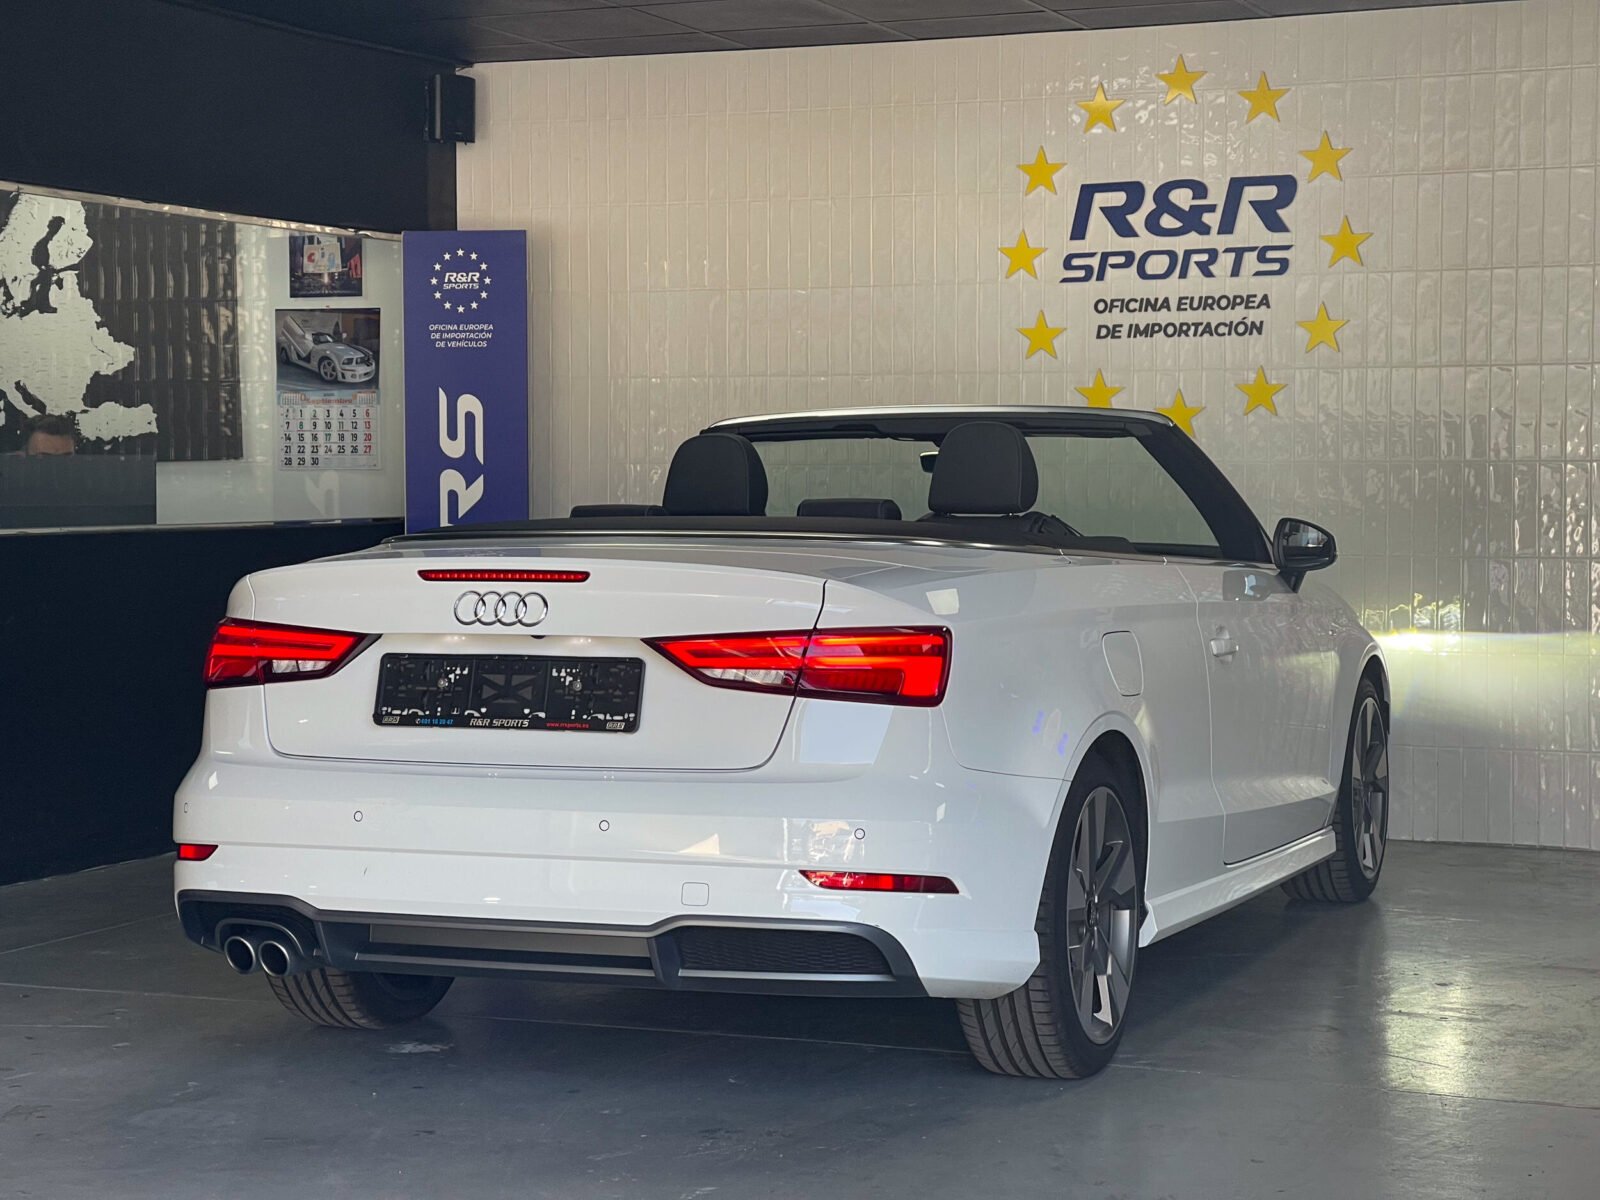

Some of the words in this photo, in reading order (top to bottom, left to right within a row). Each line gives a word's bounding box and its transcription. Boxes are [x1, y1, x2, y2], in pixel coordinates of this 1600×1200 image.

[1069, 174, 1298, 241] R&R
[1058, 244, 1294, 283] SPORTS
[444, 272, 480, 283] R&R
[1094, 297, 1171, 314] OFICINA
[1177, 294, 1271, 312] EUROPEA
[1096, 324, 1123, 339] DE
[1127, 317, 1264, 339] IMPORTACIÓN
[442, 331, 492, 339] IMPORTACIÓN
[435, 340, 446, 348] DE
[447, 339, 487, 348] VEHÍCULOS
[324, 421, 332, 429] 10
[338, 421, 344, 429] 11
[351, 421, 358, 429] 12
[364, 421, 371, 429] 13
[284, 433, 291, 441] 14
[298, 433, 305, 441] 15
[311, 433, 318, 441] 16
[325, 433, 331, 441] 17
[338, 433, 345, 441] 18
[351, 433, 358, 441] 19
[364, 433, 372, 441] 20
[284, 445, 291, 454] 21
[297, 445, 305, 454] 22
[311, 445, 319, 454] 23
[324, 445, 332, 454] 24
[338, 445, 345, 454] 25
[350, 445, 359, 454] 26
[364, 445, 372, 454] 27
[284, 457, 292, 465] 28
[297, 457, 305, 465] 29
[311, 457, 319, 465] 30
[469, 717, 490, 727] R&R
[491, 718, 530, 728] SPORTS
